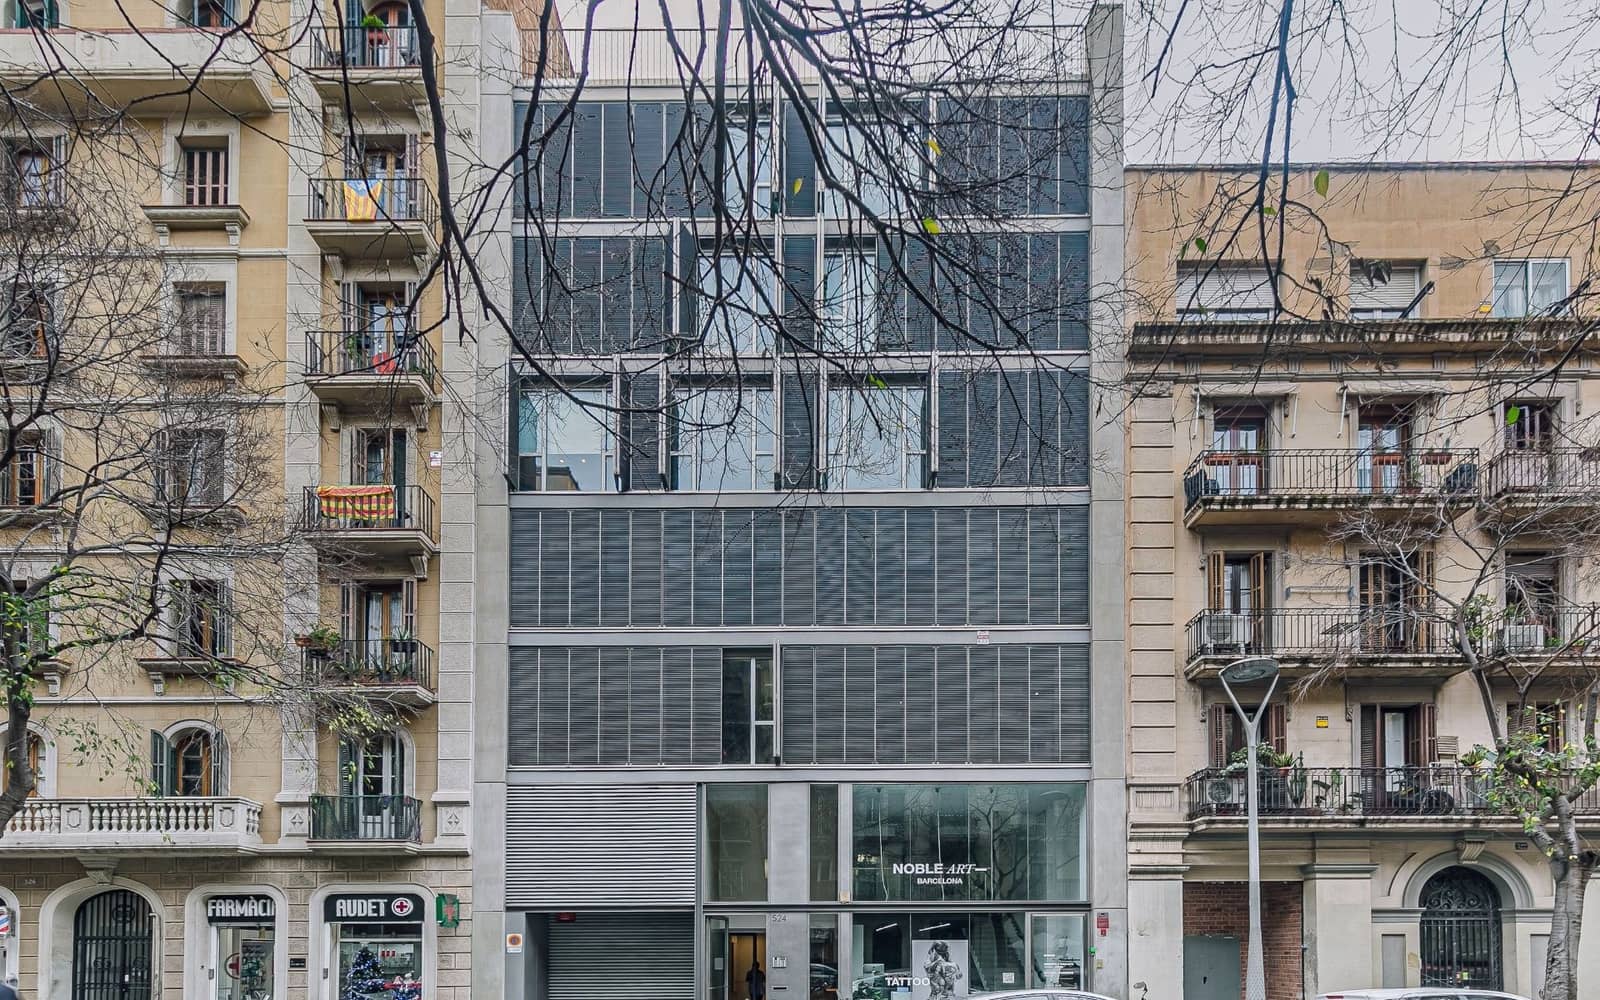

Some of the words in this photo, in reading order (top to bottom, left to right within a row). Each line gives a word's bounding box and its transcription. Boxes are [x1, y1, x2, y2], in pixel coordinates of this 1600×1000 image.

[892, 863, 944, 874] NOBLE
[916, 877, 964, 885] BARCELONA
[336, 899, 388, 917] AUDET
[771, 912, 788, 922] 524
[884, 977, 930, 986] TATTOO
